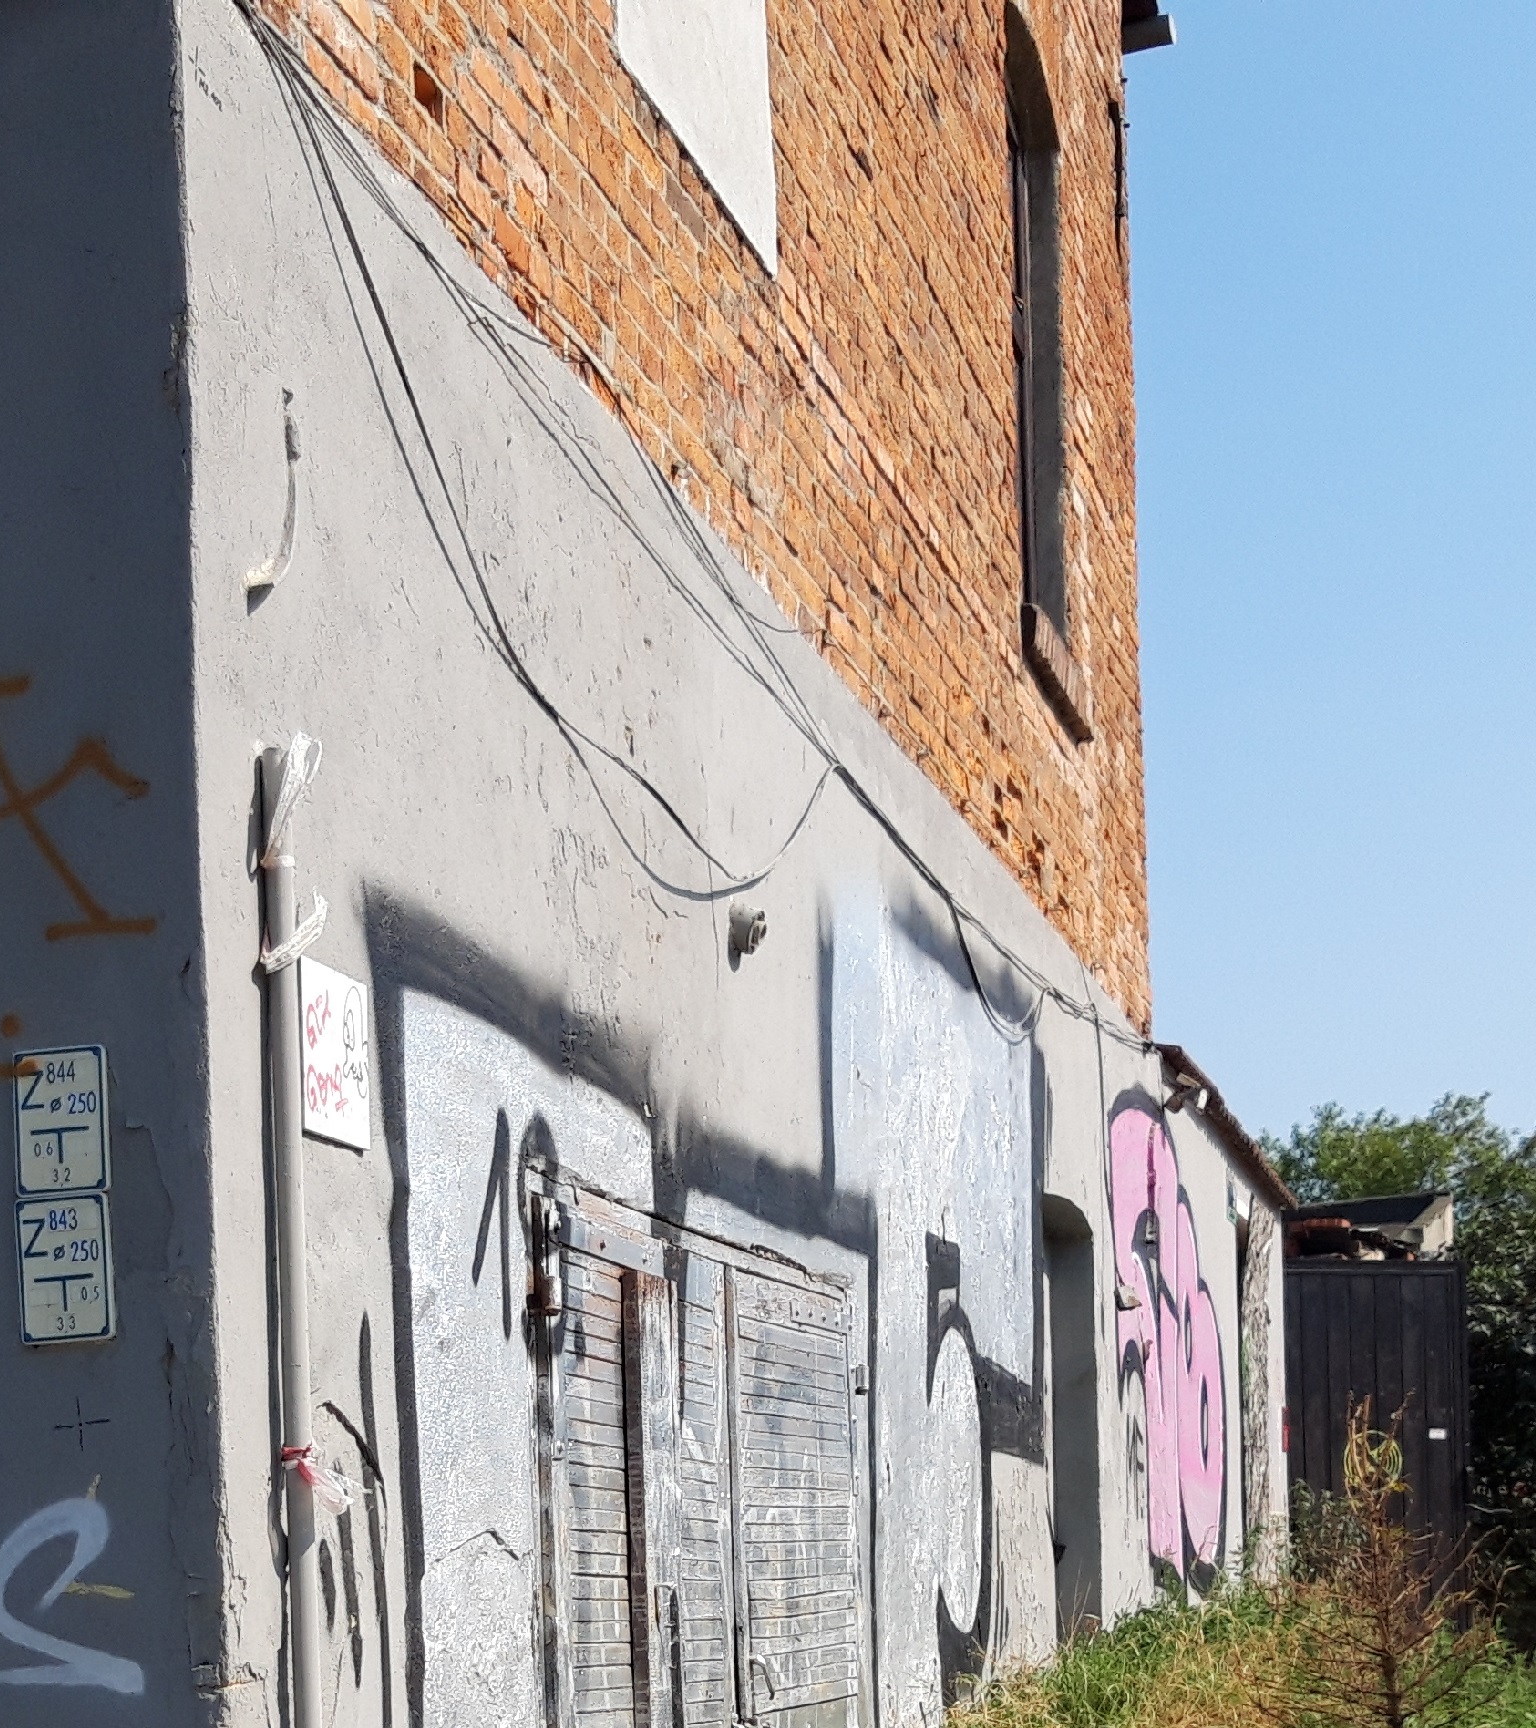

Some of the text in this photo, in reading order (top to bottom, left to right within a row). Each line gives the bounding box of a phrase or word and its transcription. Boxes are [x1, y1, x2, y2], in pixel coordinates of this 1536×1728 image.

[46, 1061, 76, 1083] 844
[68, 1091, 96, 1114] 250
[22, 1209, 78, 1259] Z 843
[70, 1239, 99, 1262] 250
